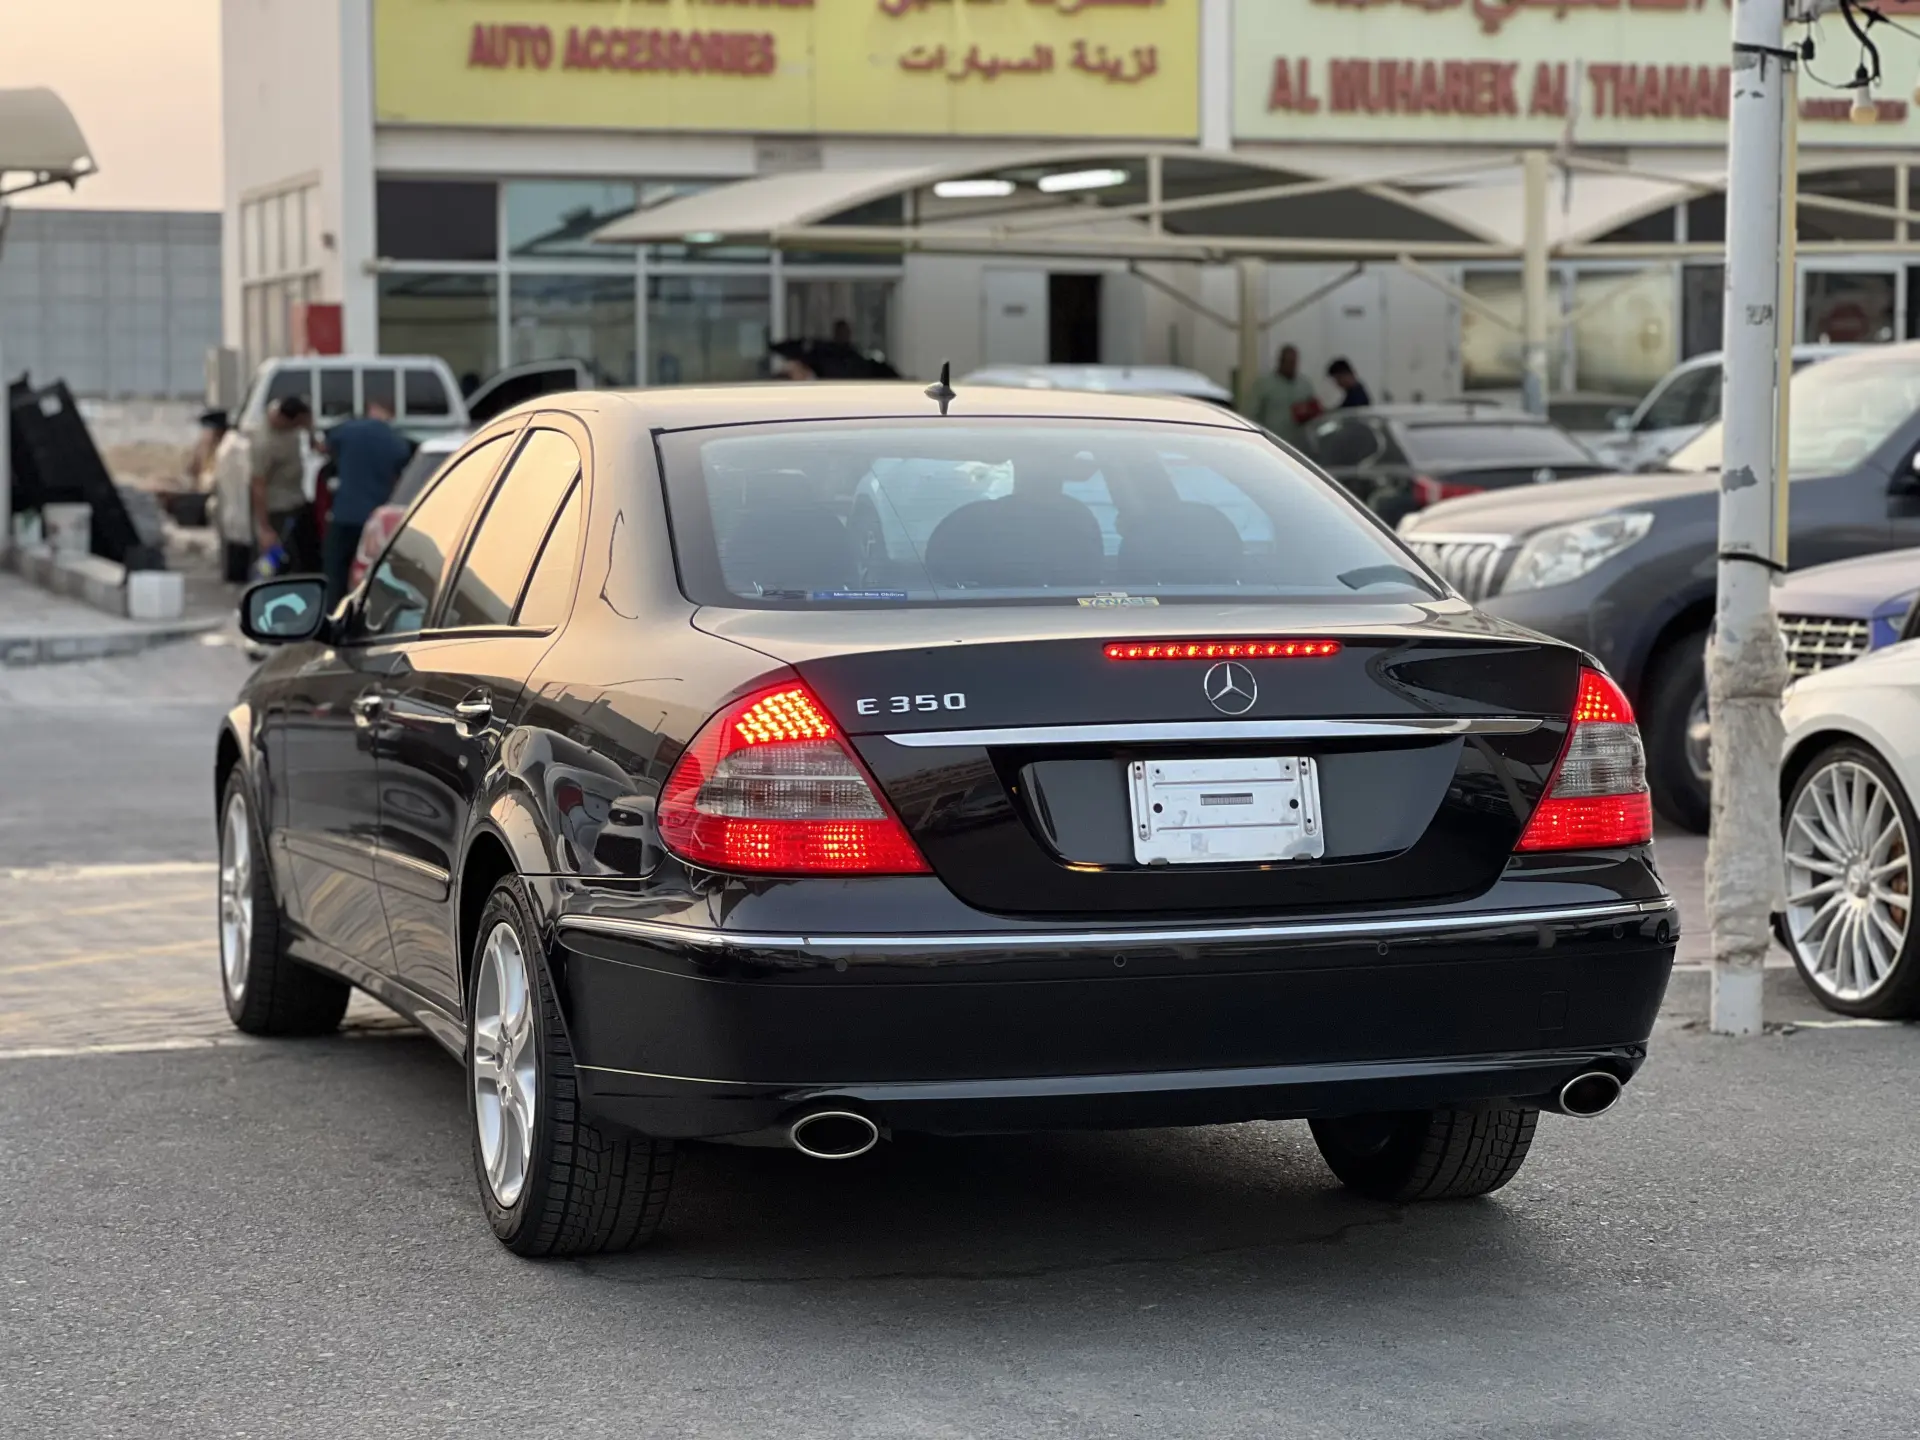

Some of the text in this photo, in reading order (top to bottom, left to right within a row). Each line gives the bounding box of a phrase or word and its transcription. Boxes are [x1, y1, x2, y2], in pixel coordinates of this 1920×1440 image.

[468, 23, 777, 77] AUTO ACCESSORIES
[899, 44, 1054, 81] السيارات
[1268, 57, 1319, 114] AL
[857, 693, 967, 715] E 350
